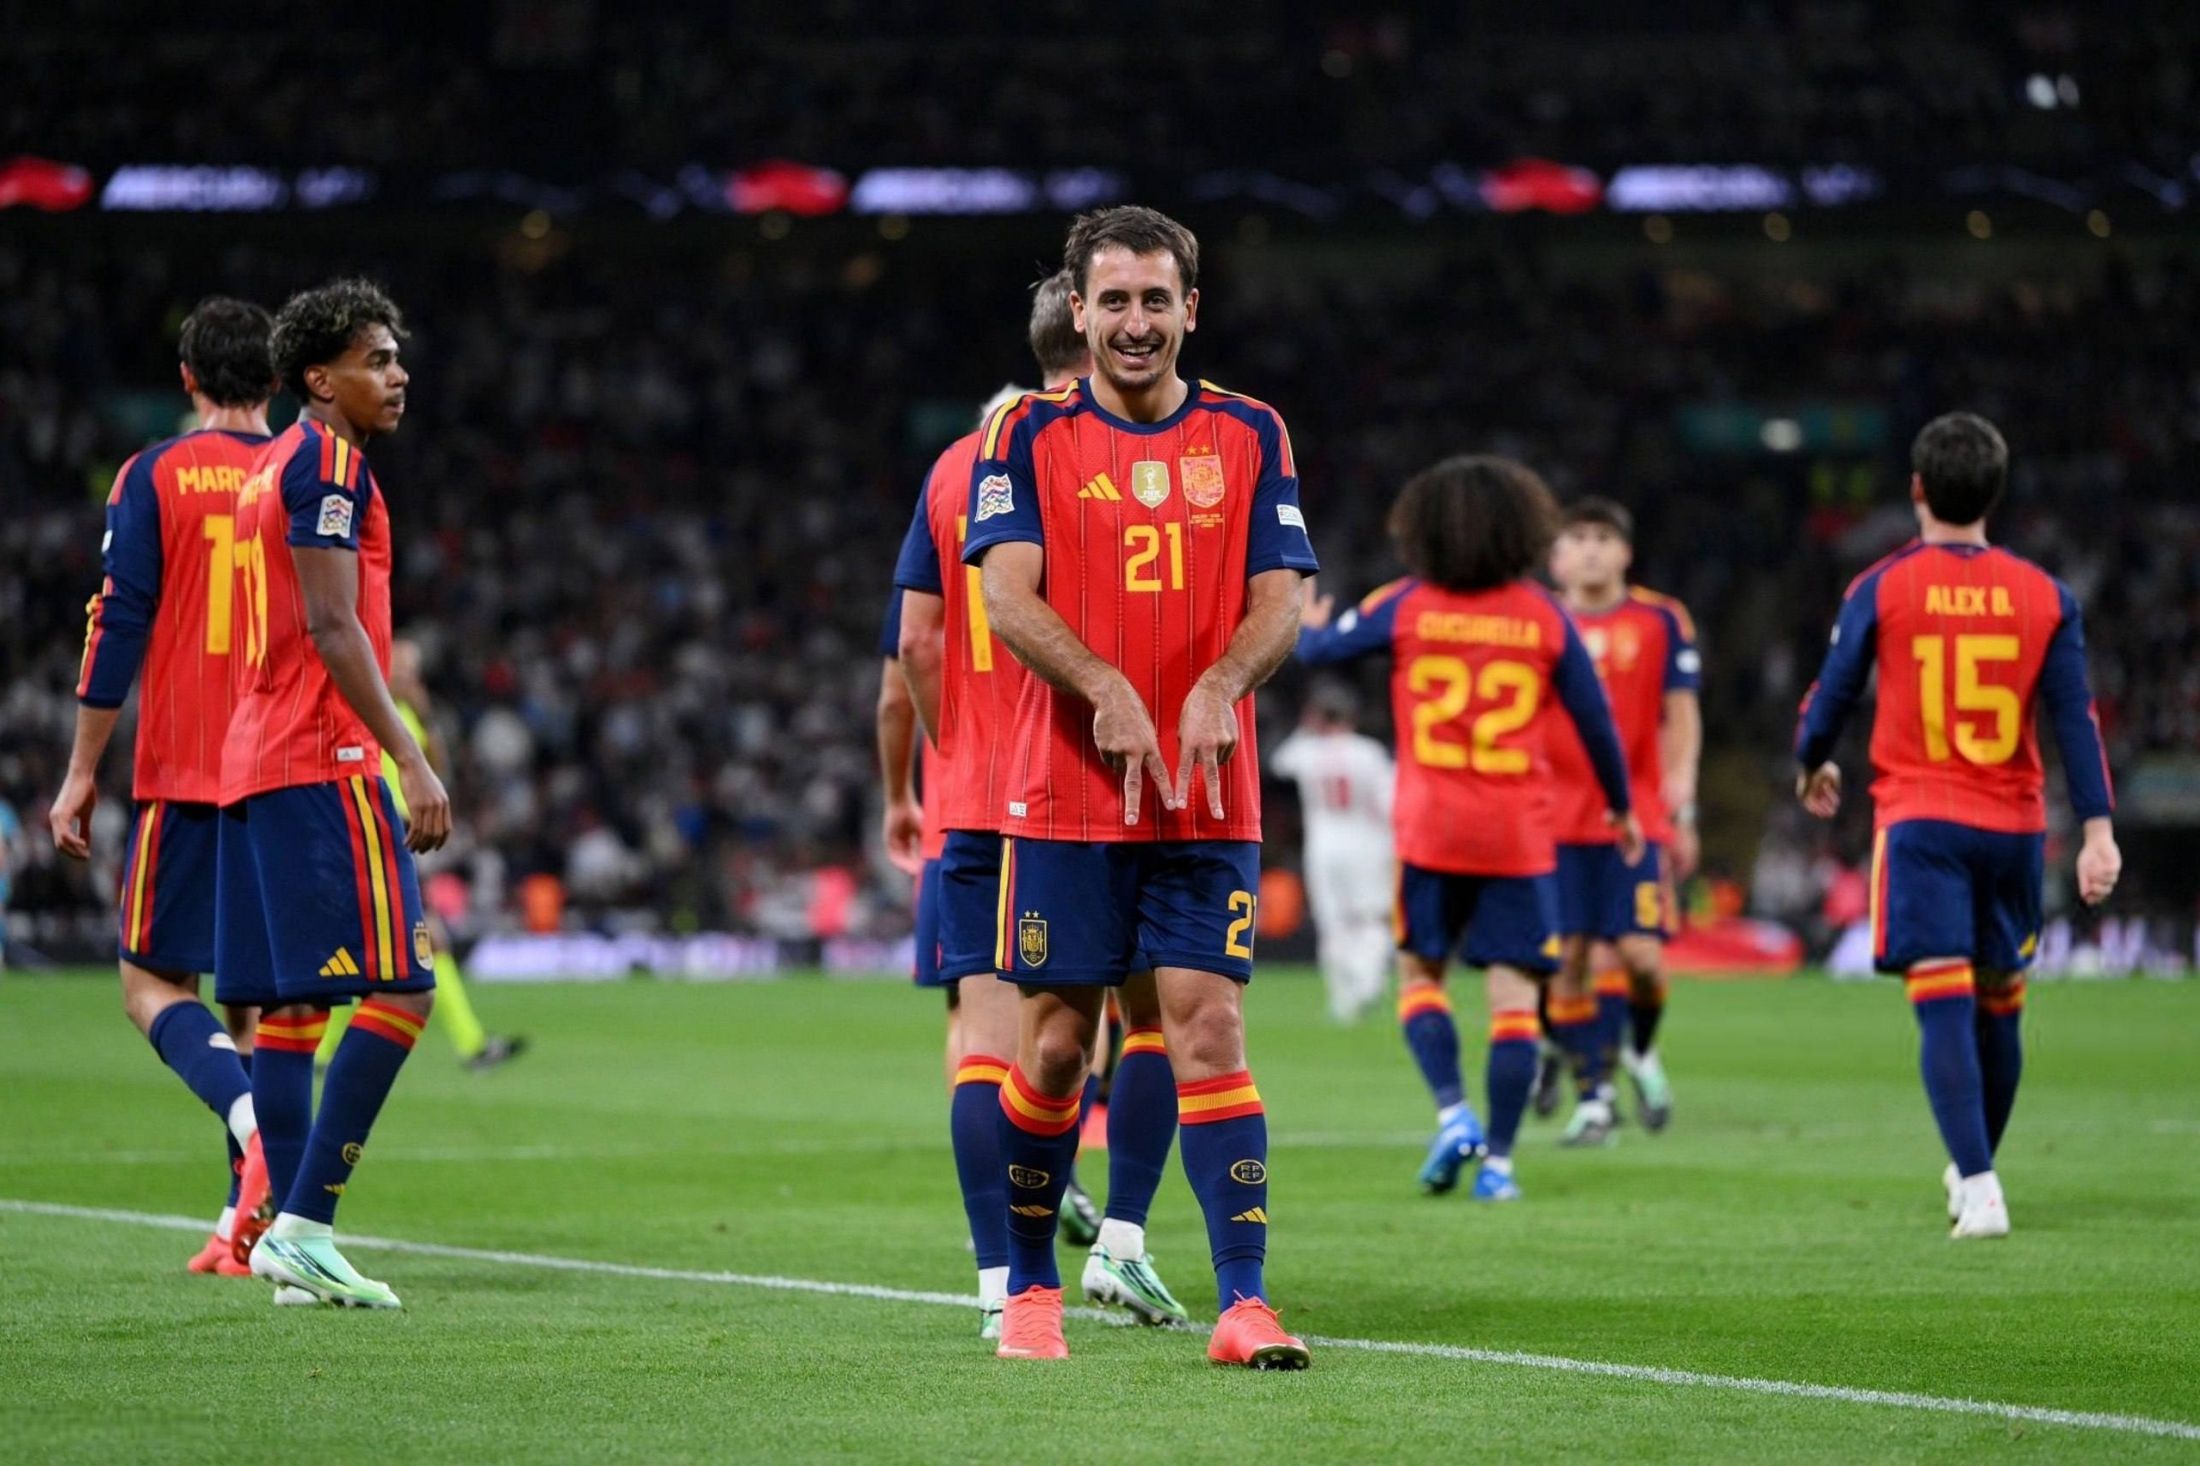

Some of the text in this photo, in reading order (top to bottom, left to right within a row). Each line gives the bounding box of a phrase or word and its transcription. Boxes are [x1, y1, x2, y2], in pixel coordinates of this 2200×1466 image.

[1125, 523, 1184, 592] 21
[1925, 584, 1987, 616] ALEX
[1408, 655, 1541, 775] 22
[1912, 635, 2020, 764] 15
